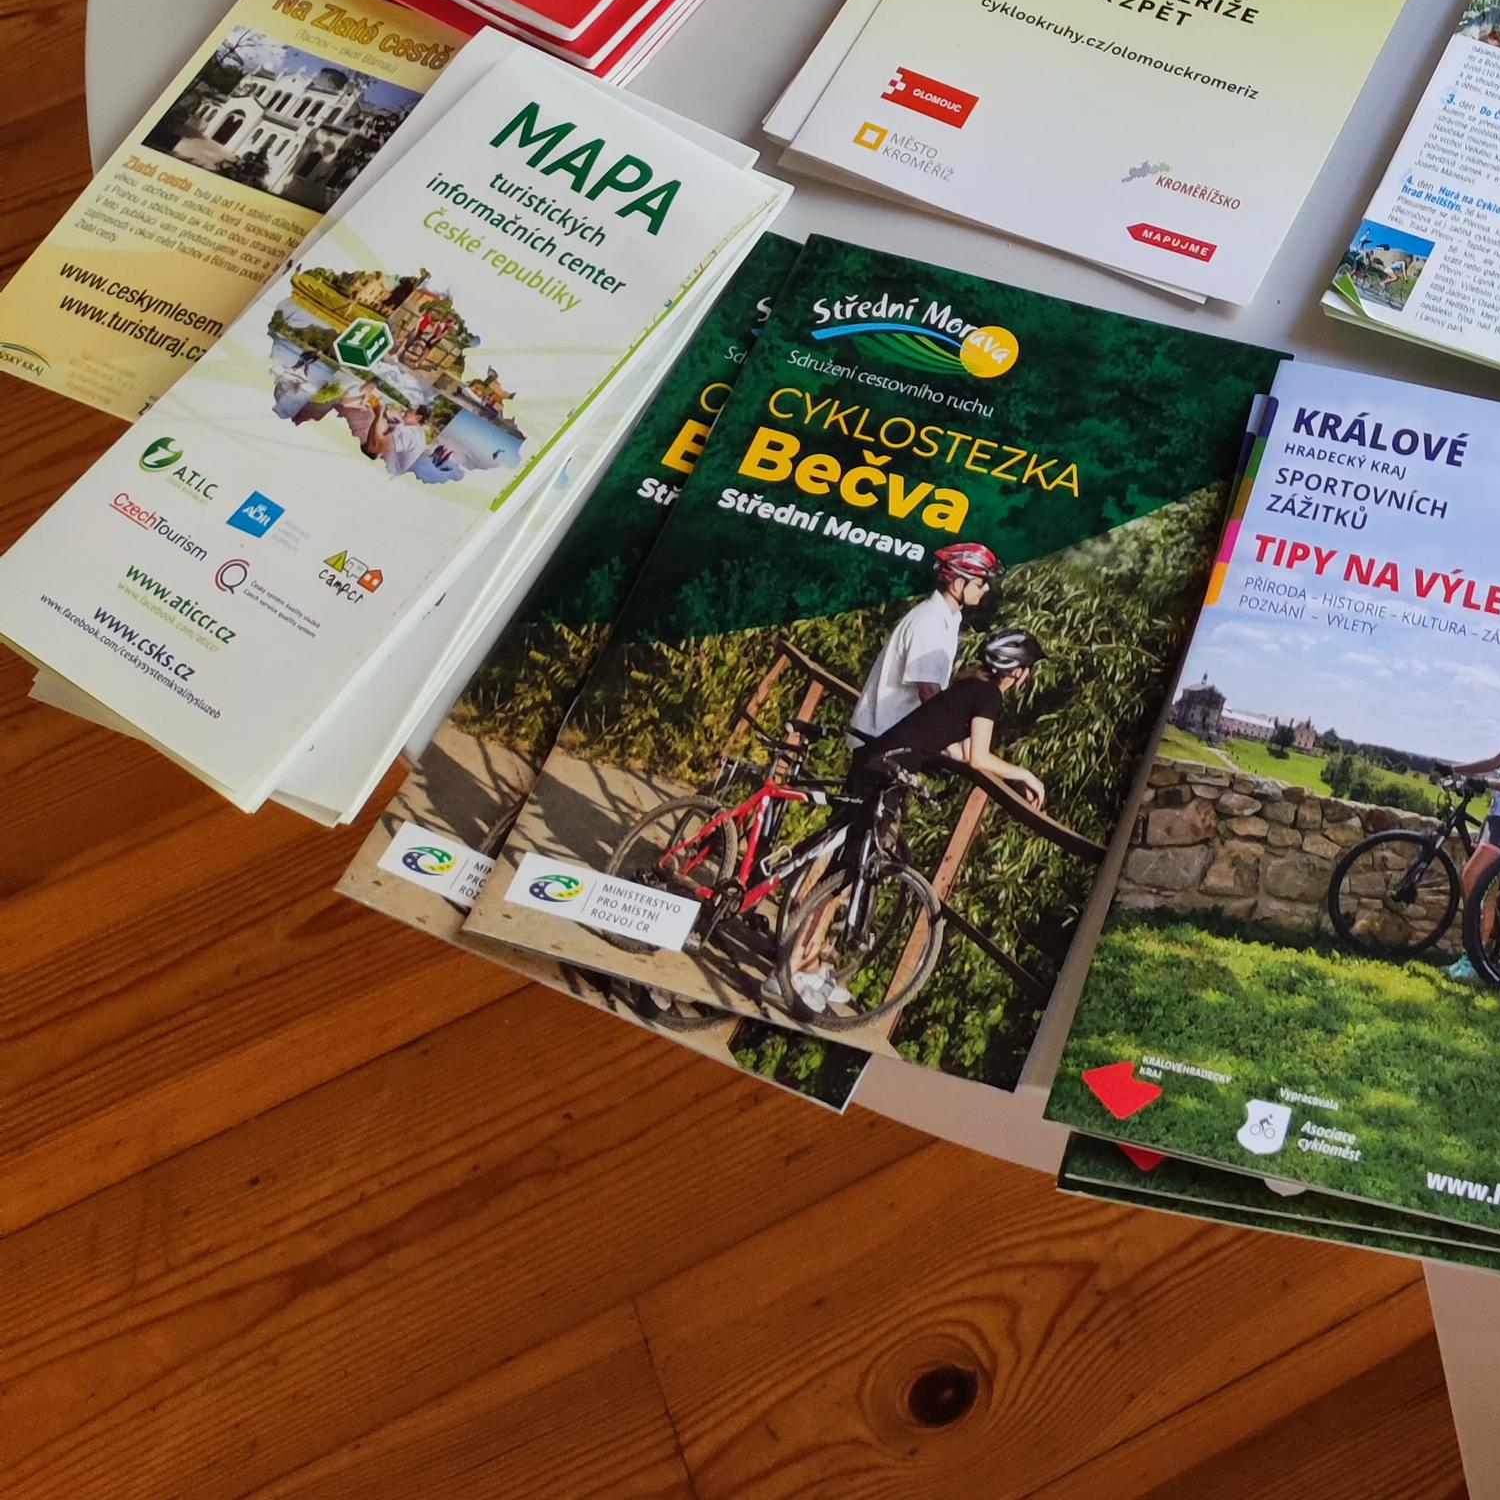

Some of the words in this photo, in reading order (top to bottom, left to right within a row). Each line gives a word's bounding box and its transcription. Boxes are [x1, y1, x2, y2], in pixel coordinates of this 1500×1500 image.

[312, 3, 380, 46] Zlaté
[379, 29, 456, 71] cestě
[912, 88, 963, 114] OLOMOUC
[489, 101, 682, 236] MAPA
[882, 145, 954, 182] KROMĚŘÍŽ
[890, 131, 938, 159] MĚSTO
[489, 172, 606, 248] turistických
[1155, 174, 1241, 210] KROMĚŘÍŽSKO
[422, 207, 483, 253] České
[481, 247, 583, 313] republiky
[426, 172, 557, 258] informačních
[557, 249, 627, 295] center
[1142, 228, 1209, 258] MAPUJME
[812, 293, 919, 325] Střední
[922, 299, 1009, 365] Morava
[787, 349, 856, 381] Sdružení
[857, 370, 944, 406] cestovního
[947, 390, 995, 419] ruchu
[768, 387, 1081, 498] CYKLOSTEZKA
[1284, 442, 1366, 470] HRADECKÝ
[1370, 460, 1407, 481] KRAJ
[1292, 407, 1470, 467] KRÁLOVÉ
[737, 425, 970, 534] Bečva
[1275, 467, 1448, 519] SPORTOVNÍCH
[113, 492, 208, 562] CzechTourism
[718, 488, 824, 532] Střední
[823, 516, 925, 563] Morava
[1266, 494, 1368, 530] ZÁŽITKŮ
[1254, 533, 1338, 576] TIPY
[1343, 554, 1400, 593] NA
[125, 564, 237, 645] www.aticcr.cz
[1239, 595, 1306, 620] POZNÁNÍ
[1327, 611, 1379, 636] VÝLETY
[1244, 576, 1308, 601] PŘÍRODA
[1322, 592, 1387, 619] HISTORIE
[1401, 610, 1467, 638] KULTURA
[93, 606, 196, 682] www.csks.cz
[590, 907, 633, 928] ROZVOJ
[635, 917, 651, 933] ČR
[595, 895, 618, 909] PRO
[621, 898, 660, 923] MÍSTNÍ
[601, 882, 682, 915] MINISTERSTVO
[1279, 1086, 1340, 1111] Vypracovala
[1297, 1134, 1362, 1164] cykloměst
[1300, 1120, 1357, 1145] Asociace
